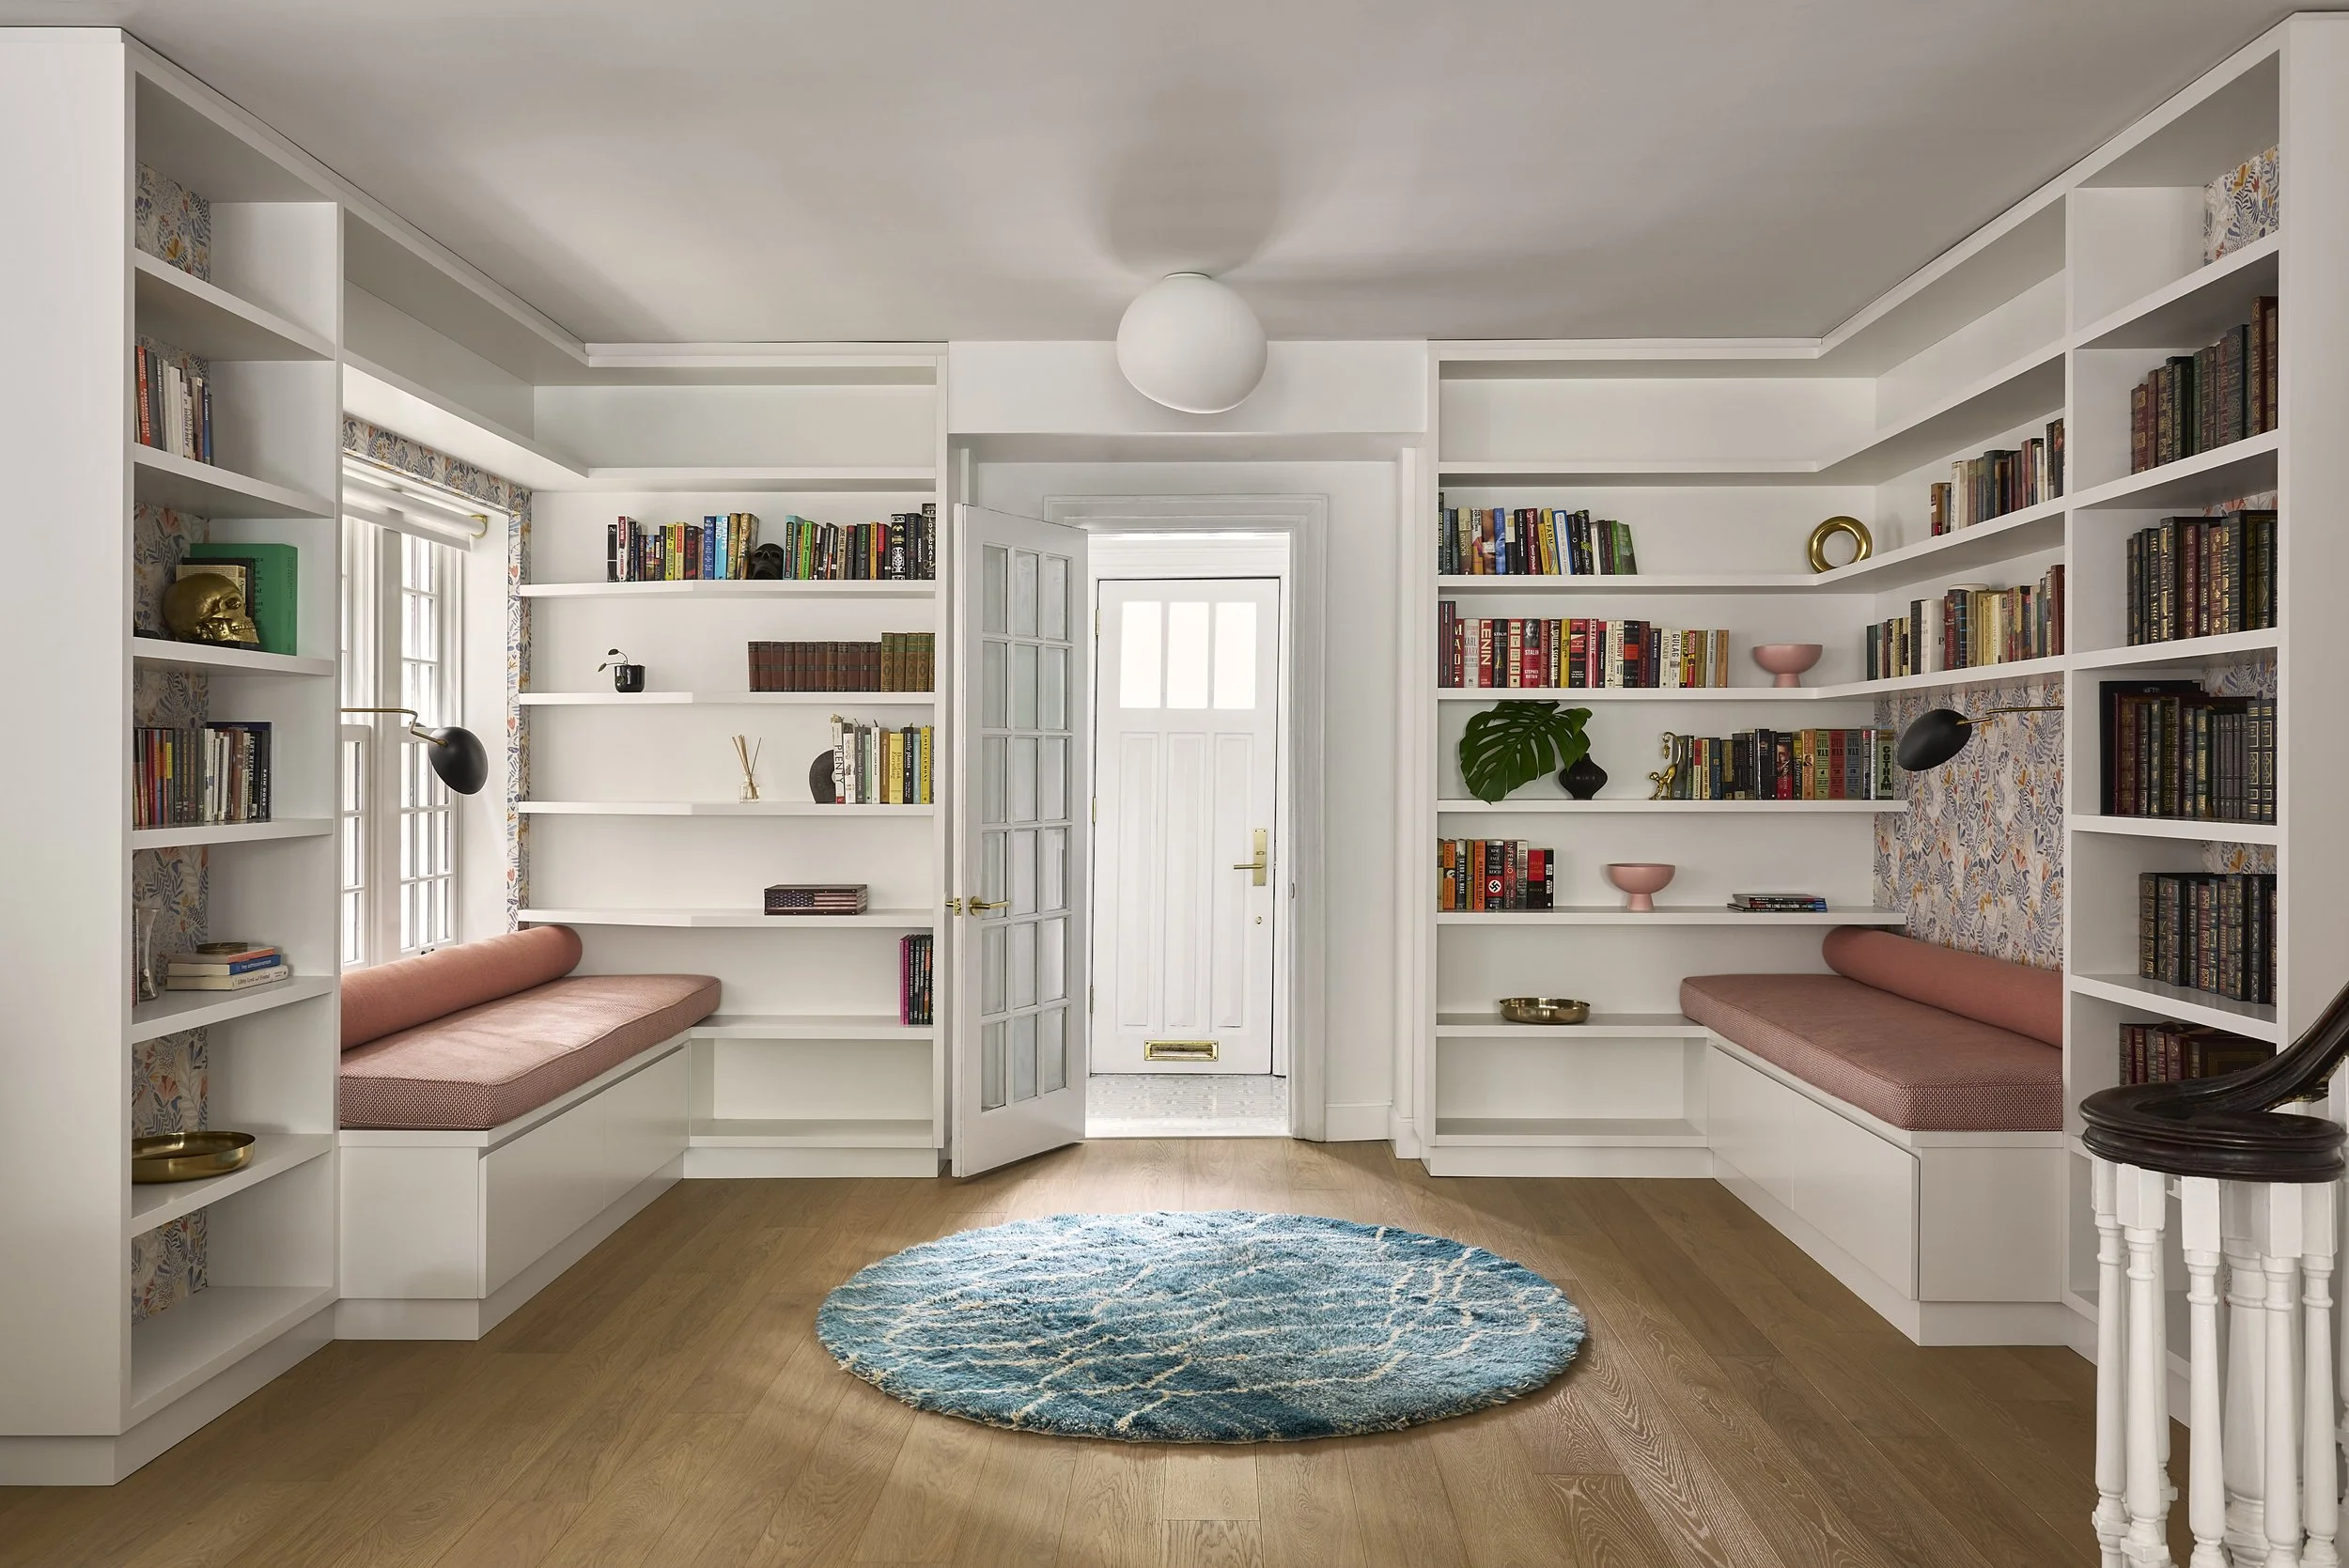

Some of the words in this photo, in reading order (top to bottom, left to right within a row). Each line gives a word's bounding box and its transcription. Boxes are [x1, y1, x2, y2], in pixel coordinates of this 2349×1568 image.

[1464, 647, 1478, 656] MARX
[1465, 637, 1476, 647] KARL
[1481, 621, 1491, 665] LENIN
[1672, 634, 1680, 657] GULAG
[1817, 739, 1828, 748] CIVIL
[1832, 739, 1843, 748] CIVIL
[1848, 738, 1859, 747] CIVIL
[835, 745, 844, 784] PLENTY
[1781, 760, 1790, 790] NAPOLEON
[1795, 750, 1803, 786] Mayflower
[1881, 746, 1891, 790] GOTHAM
